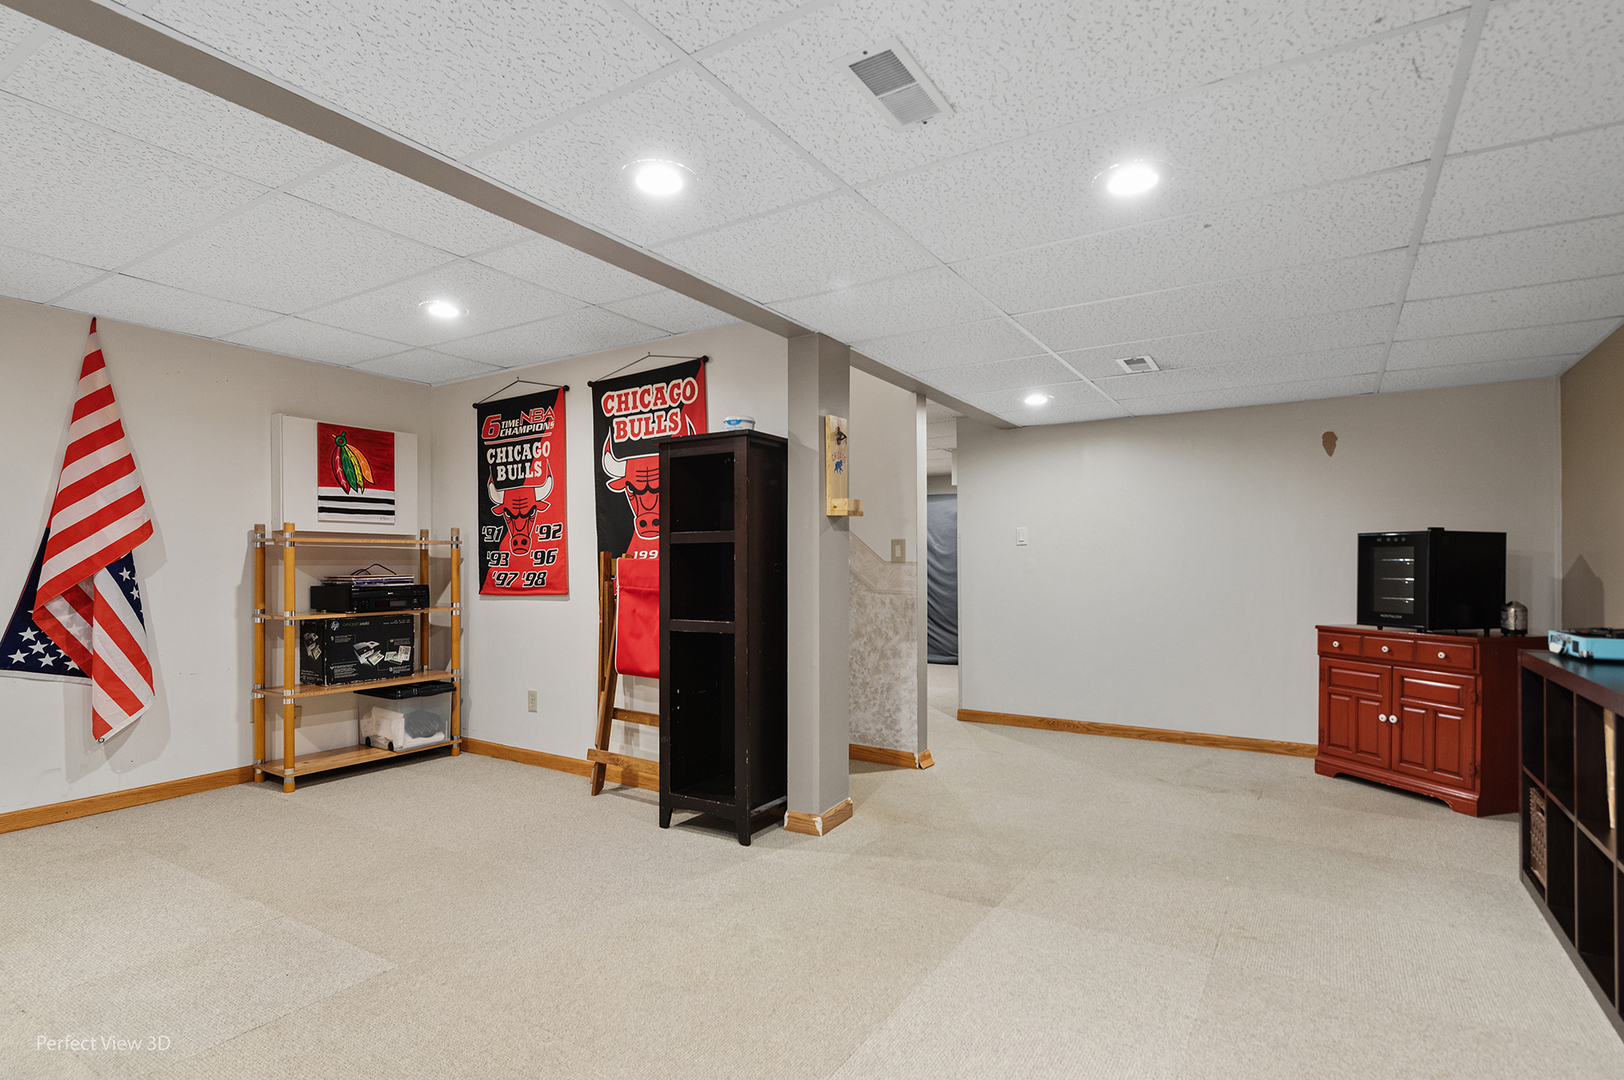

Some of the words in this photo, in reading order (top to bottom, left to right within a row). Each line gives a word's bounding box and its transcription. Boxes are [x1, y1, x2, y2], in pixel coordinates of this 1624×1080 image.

[601, 377, 698, 417] CHICAGO
[481, 414, 501, 439] 6
[501, 419, 520, 429] TIME
[520, 406, 556, 425] NBA
[500, 421, 555, 437] CHAMPIONS
[613, 408, 681, 443] BULLS
[486, 441, 551, 464] CHICAGO
[496, 460, 542, 481] BULLS
[481, 526, 504, 542] '91
[535, 522, 563, 541] '92
[486, 551, 510, 567] '93
[530, 548, 558, 566] '96
[634, 550, 659, 559] 199
[492, 571, 520, 587] '97
[522, 570, 547, 587] '98
